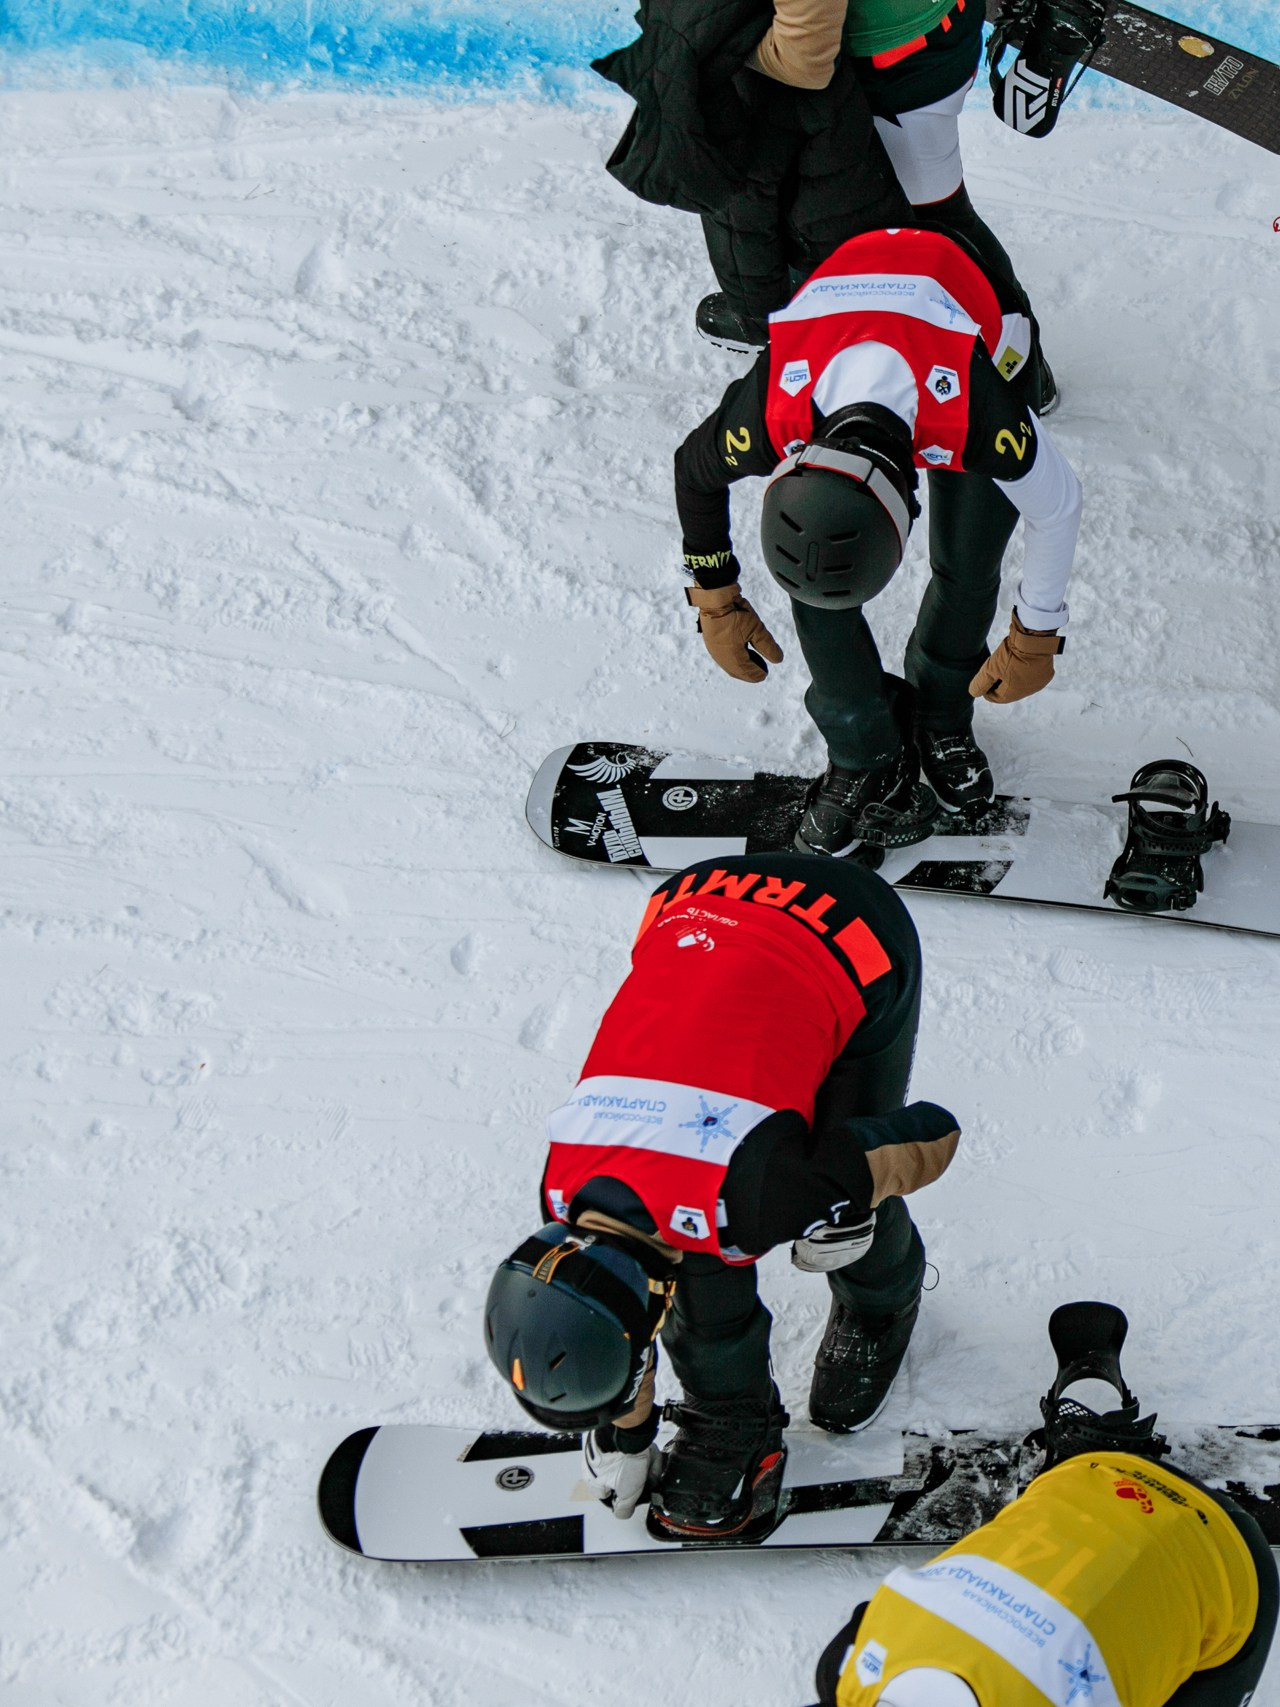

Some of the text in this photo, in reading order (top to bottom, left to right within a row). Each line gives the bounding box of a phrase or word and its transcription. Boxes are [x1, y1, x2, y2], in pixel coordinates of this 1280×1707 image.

[1203, 55, 1244, 96] BX/170
[811, 283, 917, 295] СПАРТАКИАДА
[586, 812, 608, 847] V-MOTION
[948, 1565, 1057, 1637] СПАРТАКИАДА
[961, 1588, 1047, 1649] ВСЕРОССИЙСКАЯ
